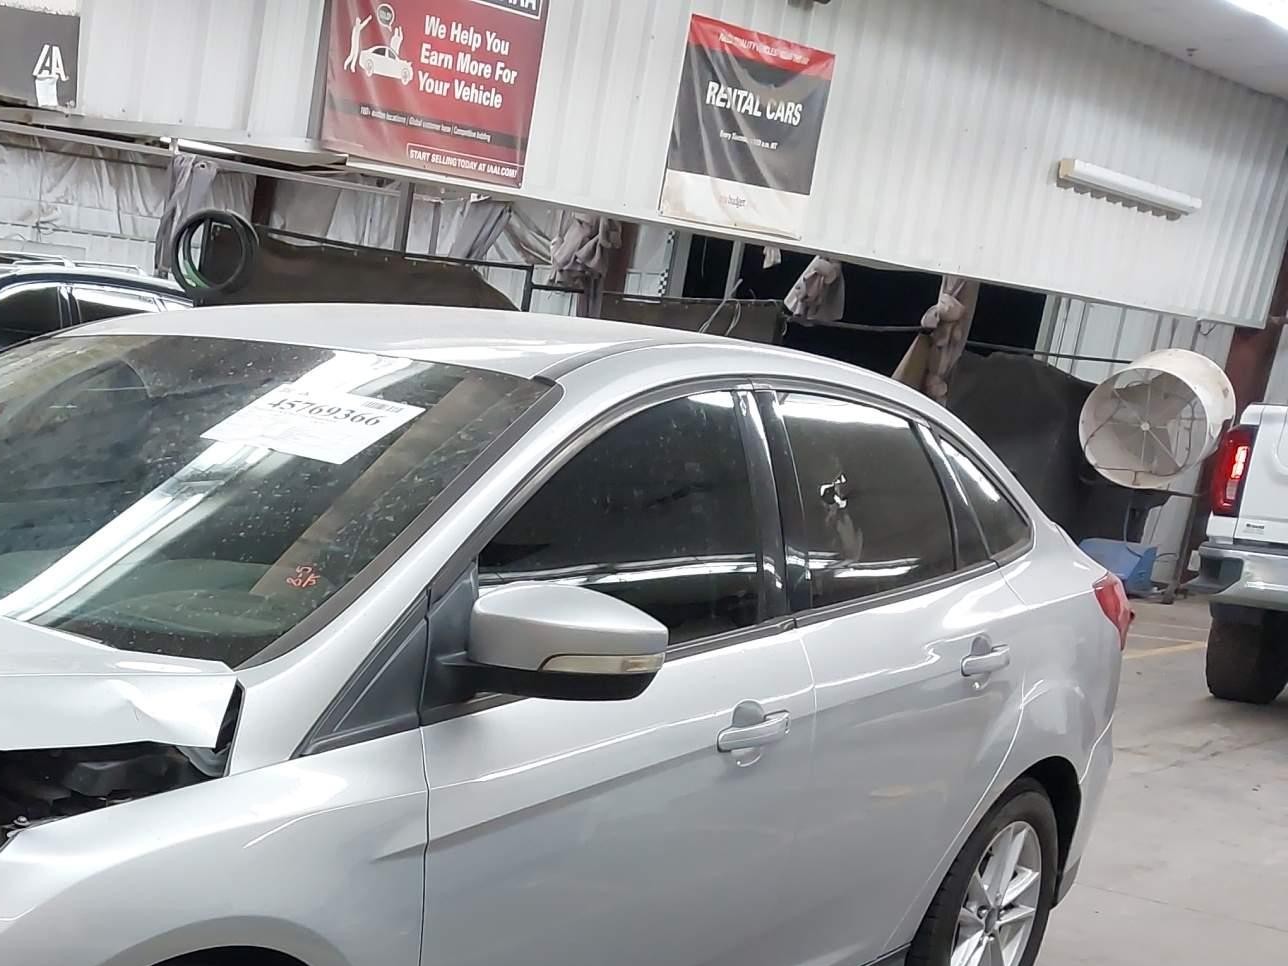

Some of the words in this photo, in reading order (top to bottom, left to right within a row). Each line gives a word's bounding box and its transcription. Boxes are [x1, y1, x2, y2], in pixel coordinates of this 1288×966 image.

[424, 14, 445, 39] We
[450, 22, 482, 51] Help
[485, 31, 510, 56] You
[420, 43, 453, 69] Earn
[456, 52, 492, 79] More
[494, 62, 518, 85] For
[417, 71, 450, 97] Your
[454, 79, 503, 108] Vehicle
[706, 81, 762, 117] RENTAL
[766, 99, 803, 126] CARS
[409, 150, 430, 163] START
[430, 153, 457, 167] SELLING
[457, 158, 478, 171] TODAY
[477, 162, 486, 172] AT
[268, 398, 386, 426] 45769366
